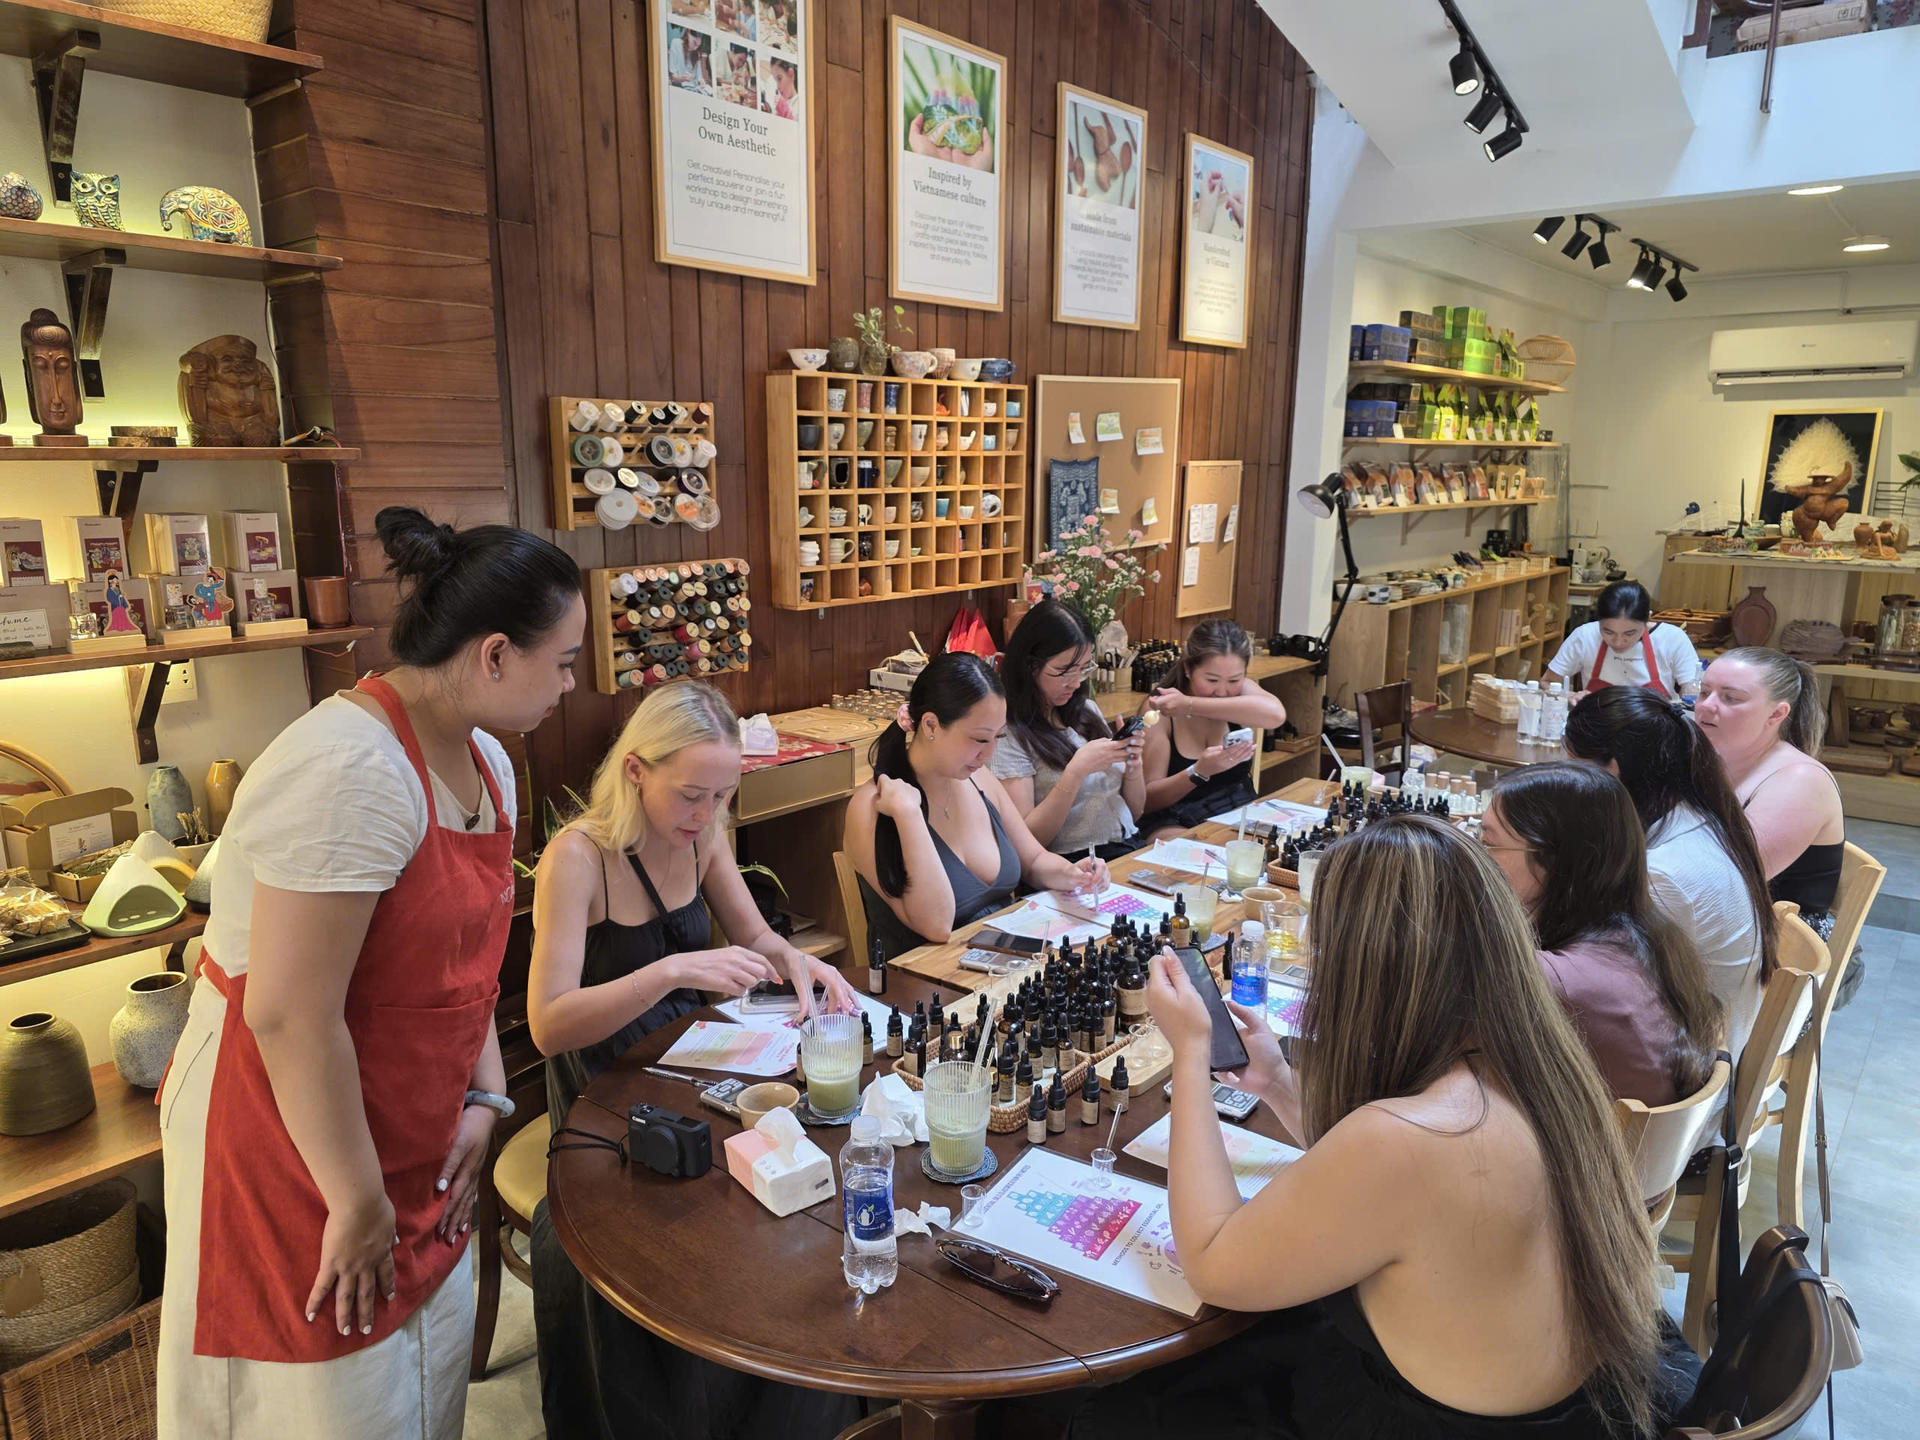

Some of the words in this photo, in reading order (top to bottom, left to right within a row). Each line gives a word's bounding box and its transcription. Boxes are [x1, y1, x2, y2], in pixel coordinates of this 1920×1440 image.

[702, 107, 740, 130] Design
[743, 118, 768, 136] Your
[698, 126, 723, 144] Own
[727, 134, 776, 157] Aesthetic
[688, 171, 713, 185] perfect
[928, 167, 960, 184] Inspired
[962, 175, 972, 190] by
[686, 182, 719, 198] workshop
[721, 190, 727, 198] to
[729, 191, 752, 205] design
[753, 198, 787, 213] something
[707, 199, 730, 212] unique
[913, 180, 958, 200] Vietnamese
[960, 192, 986, 207] culture
[1130, 1226, 1144, 1243] COLLECT
